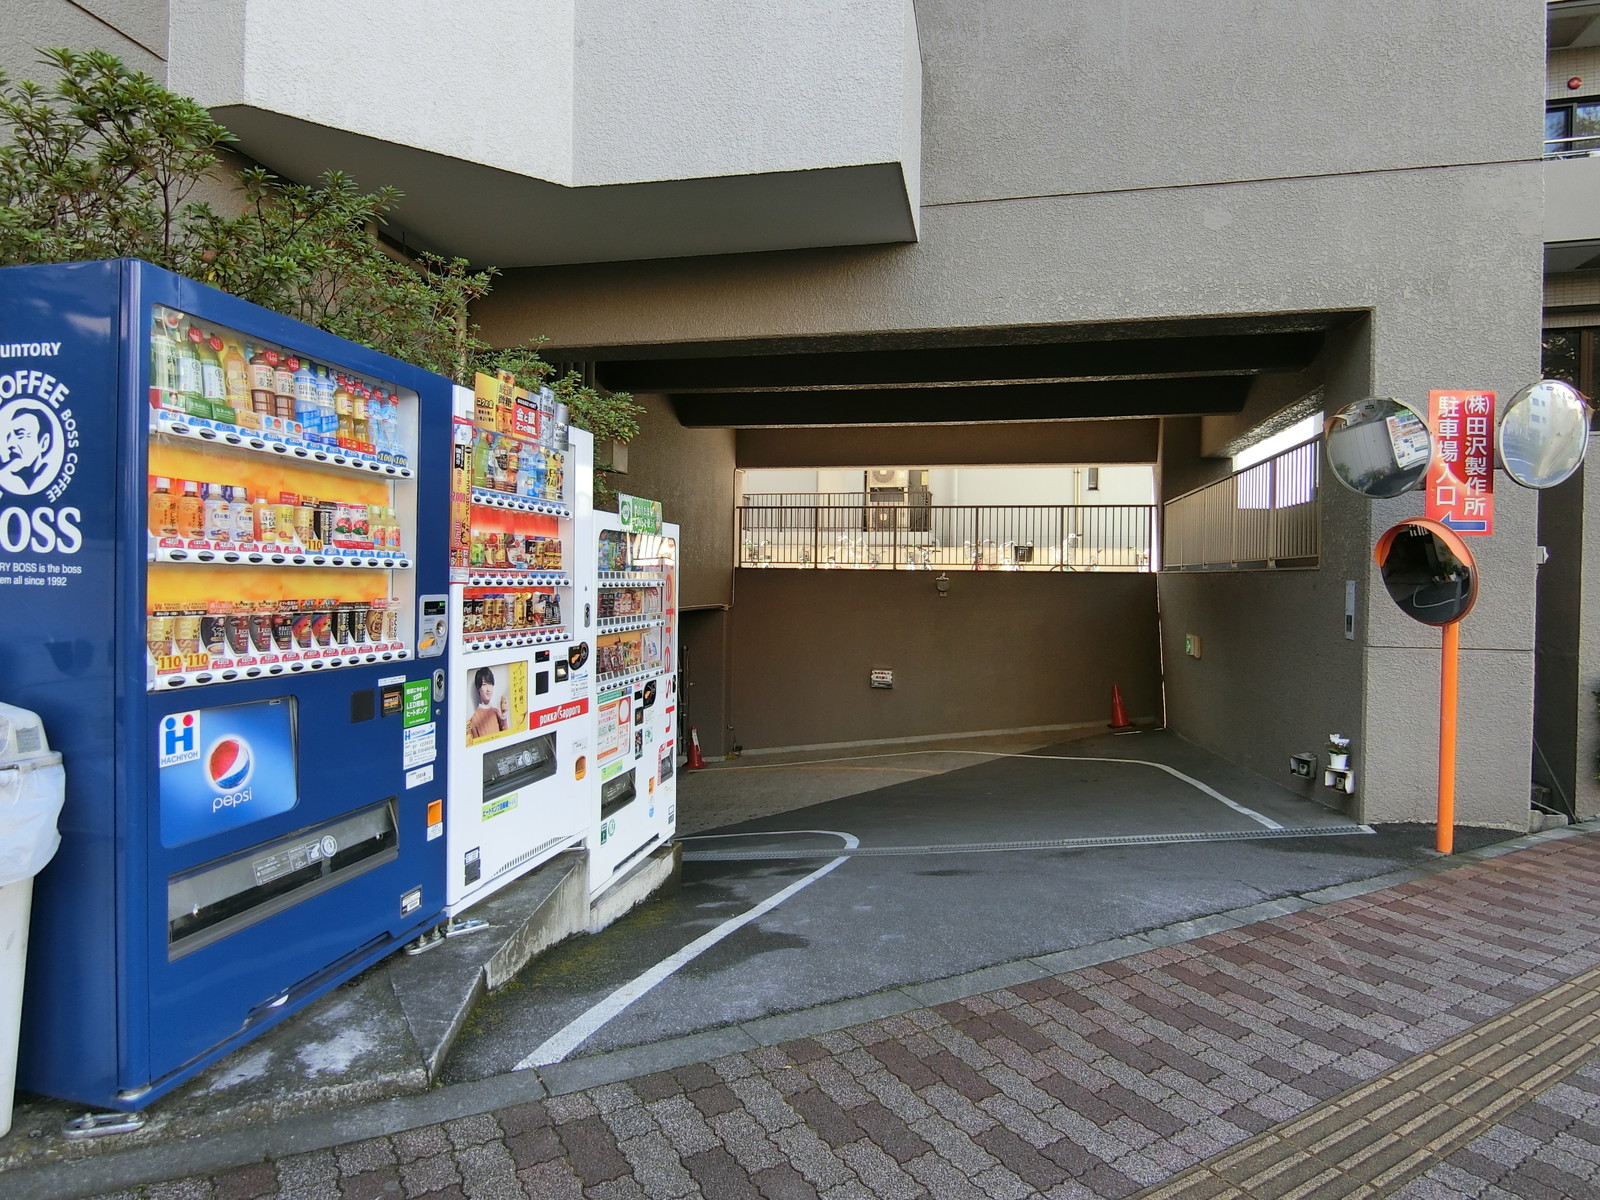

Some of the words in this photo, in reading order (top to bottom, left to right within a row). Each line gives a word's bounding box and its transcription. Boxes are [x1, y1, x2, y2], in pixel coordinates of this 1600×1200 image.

[0, 370, 70, 409] OFFEE
[61, 408, 79, 448] BOSS
[1436, 396, 1459, 506] 駐車場入口
[45, 453, 78, 503] COFFEE
[307, 541, 322, 551] 110
[13, 563, 37, 573] BOSS
[39, 563, 46, 573] is
[47, 564, 60, 573] the
[62, 564, 82, 574] boss
[13, 575, 23, 585] all
[24, 576, 45, 586] since
[47, 577, 67, 587] 1992
[160, 656, 181, 669] 110
[188, 653, 208, 666] 110
[161, 751, 198, 766] HACHIYOH
[212, 787, 252, 813] pepsi
